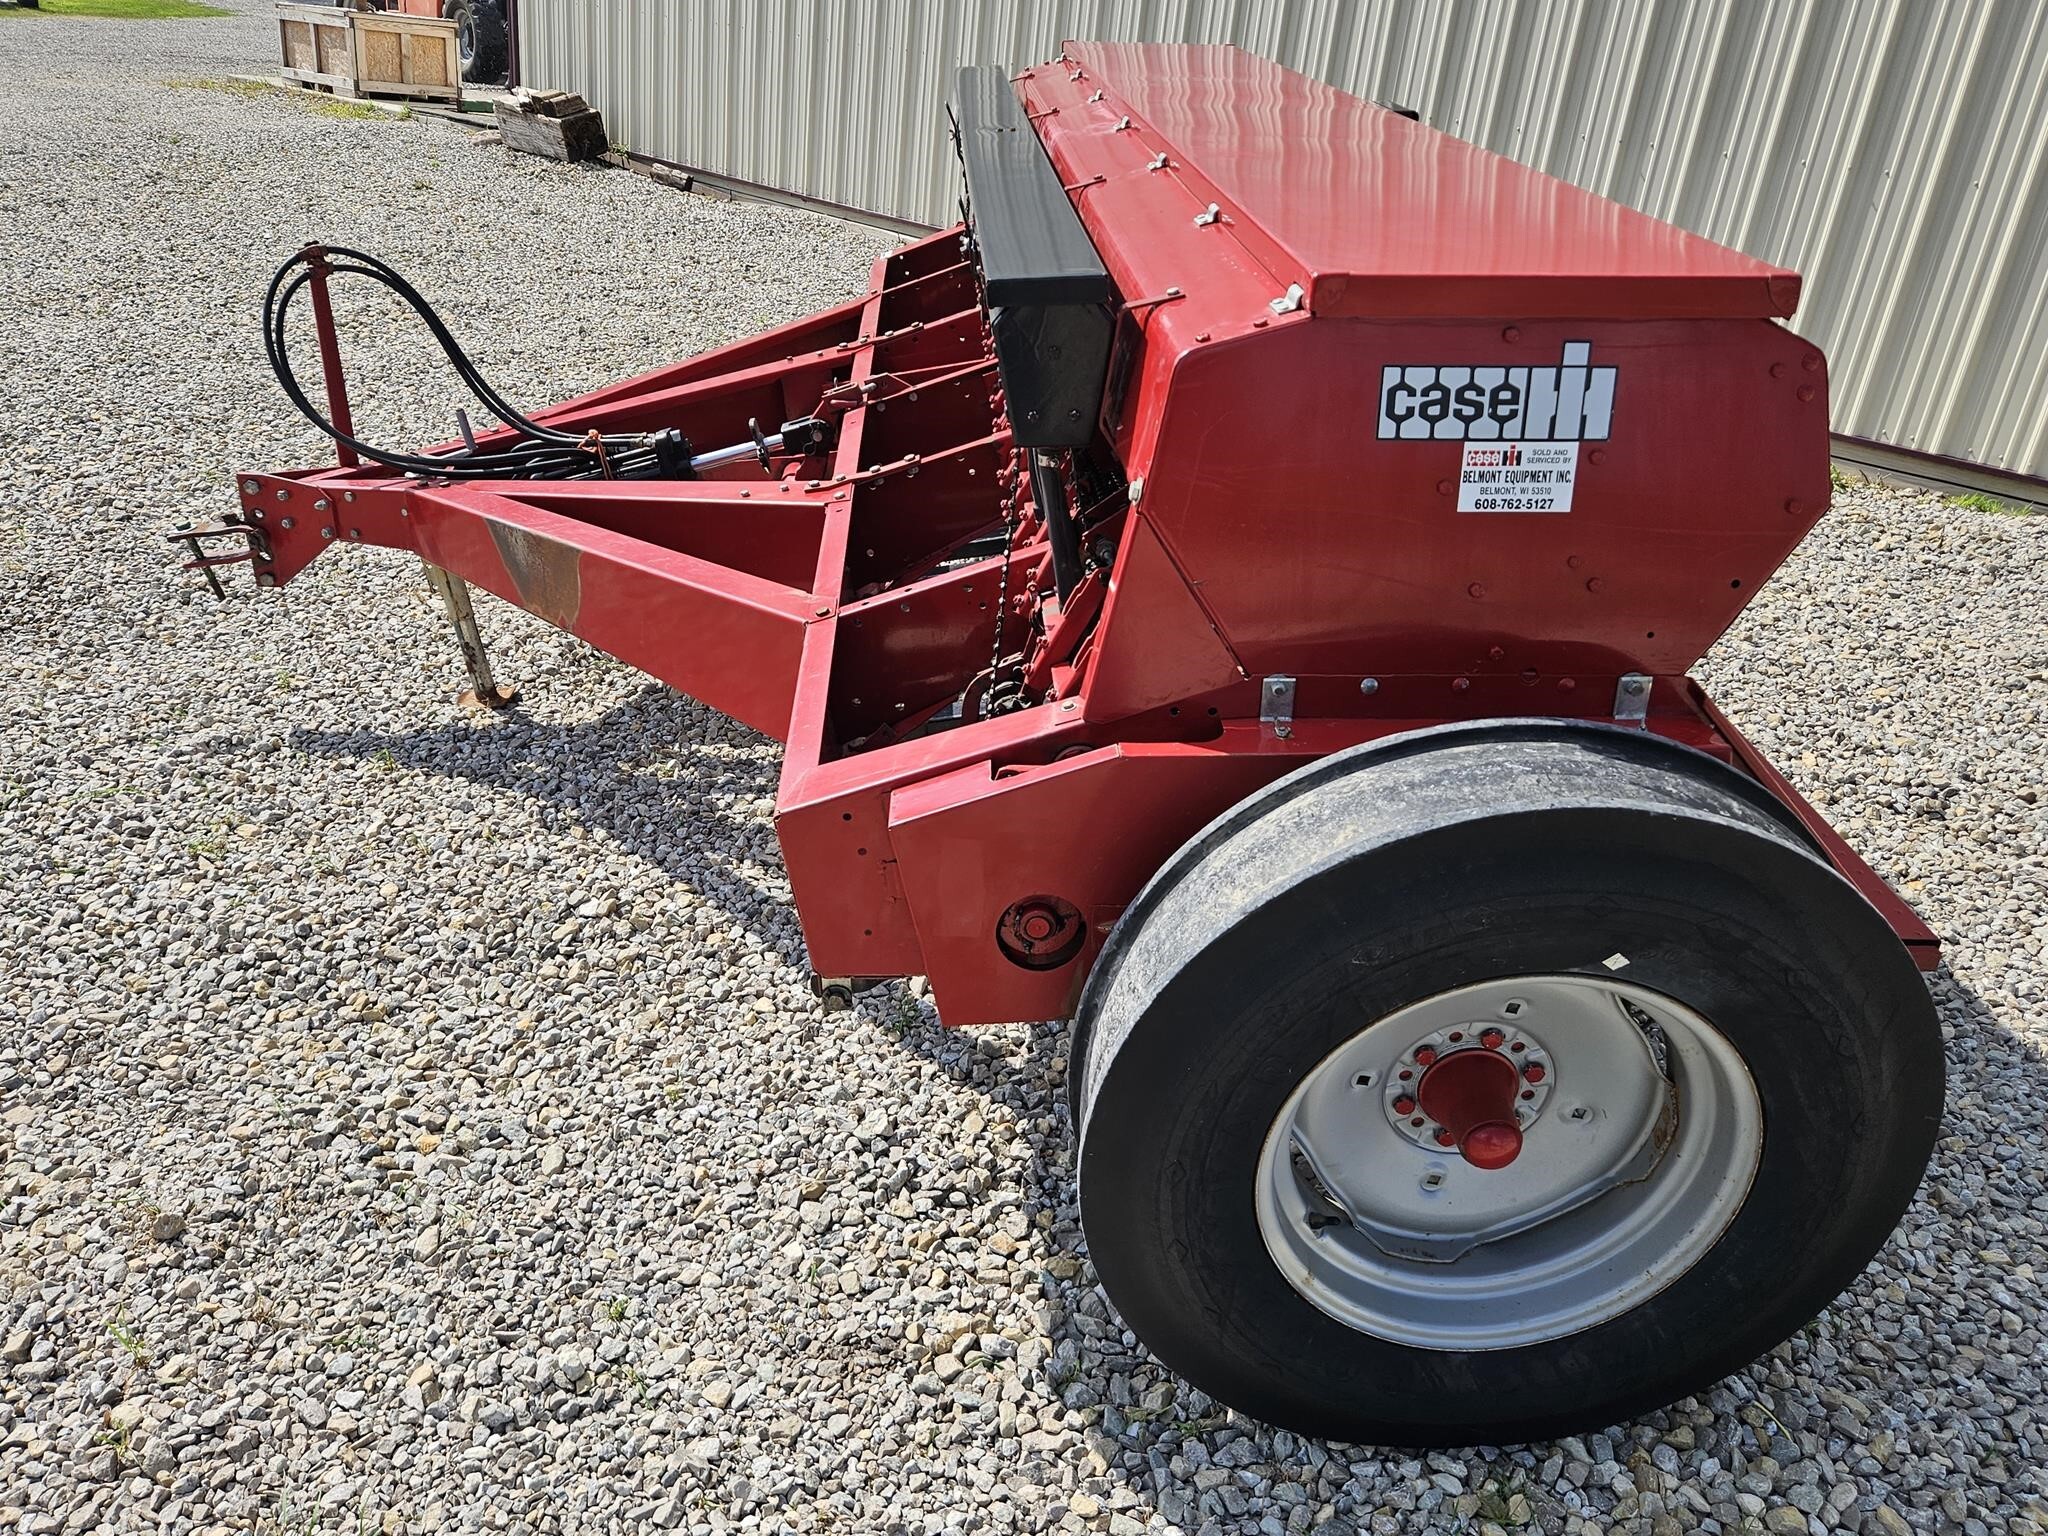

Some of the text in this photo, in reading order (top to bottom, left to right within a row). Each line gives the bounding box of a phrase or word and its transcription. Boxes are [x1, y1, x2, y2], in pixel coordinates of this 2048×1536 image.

[1532, 448, 1551, 456] SOLD
[1527, 456, 1560, 464] SERVICED
[1462, 470, 1572, 485] BELMONT EQUIPMENT INC.
[1479, 487, 1552, 496] BELMONT, WI 53510
[1475, 498, 1554, 510] 608-762-5127
